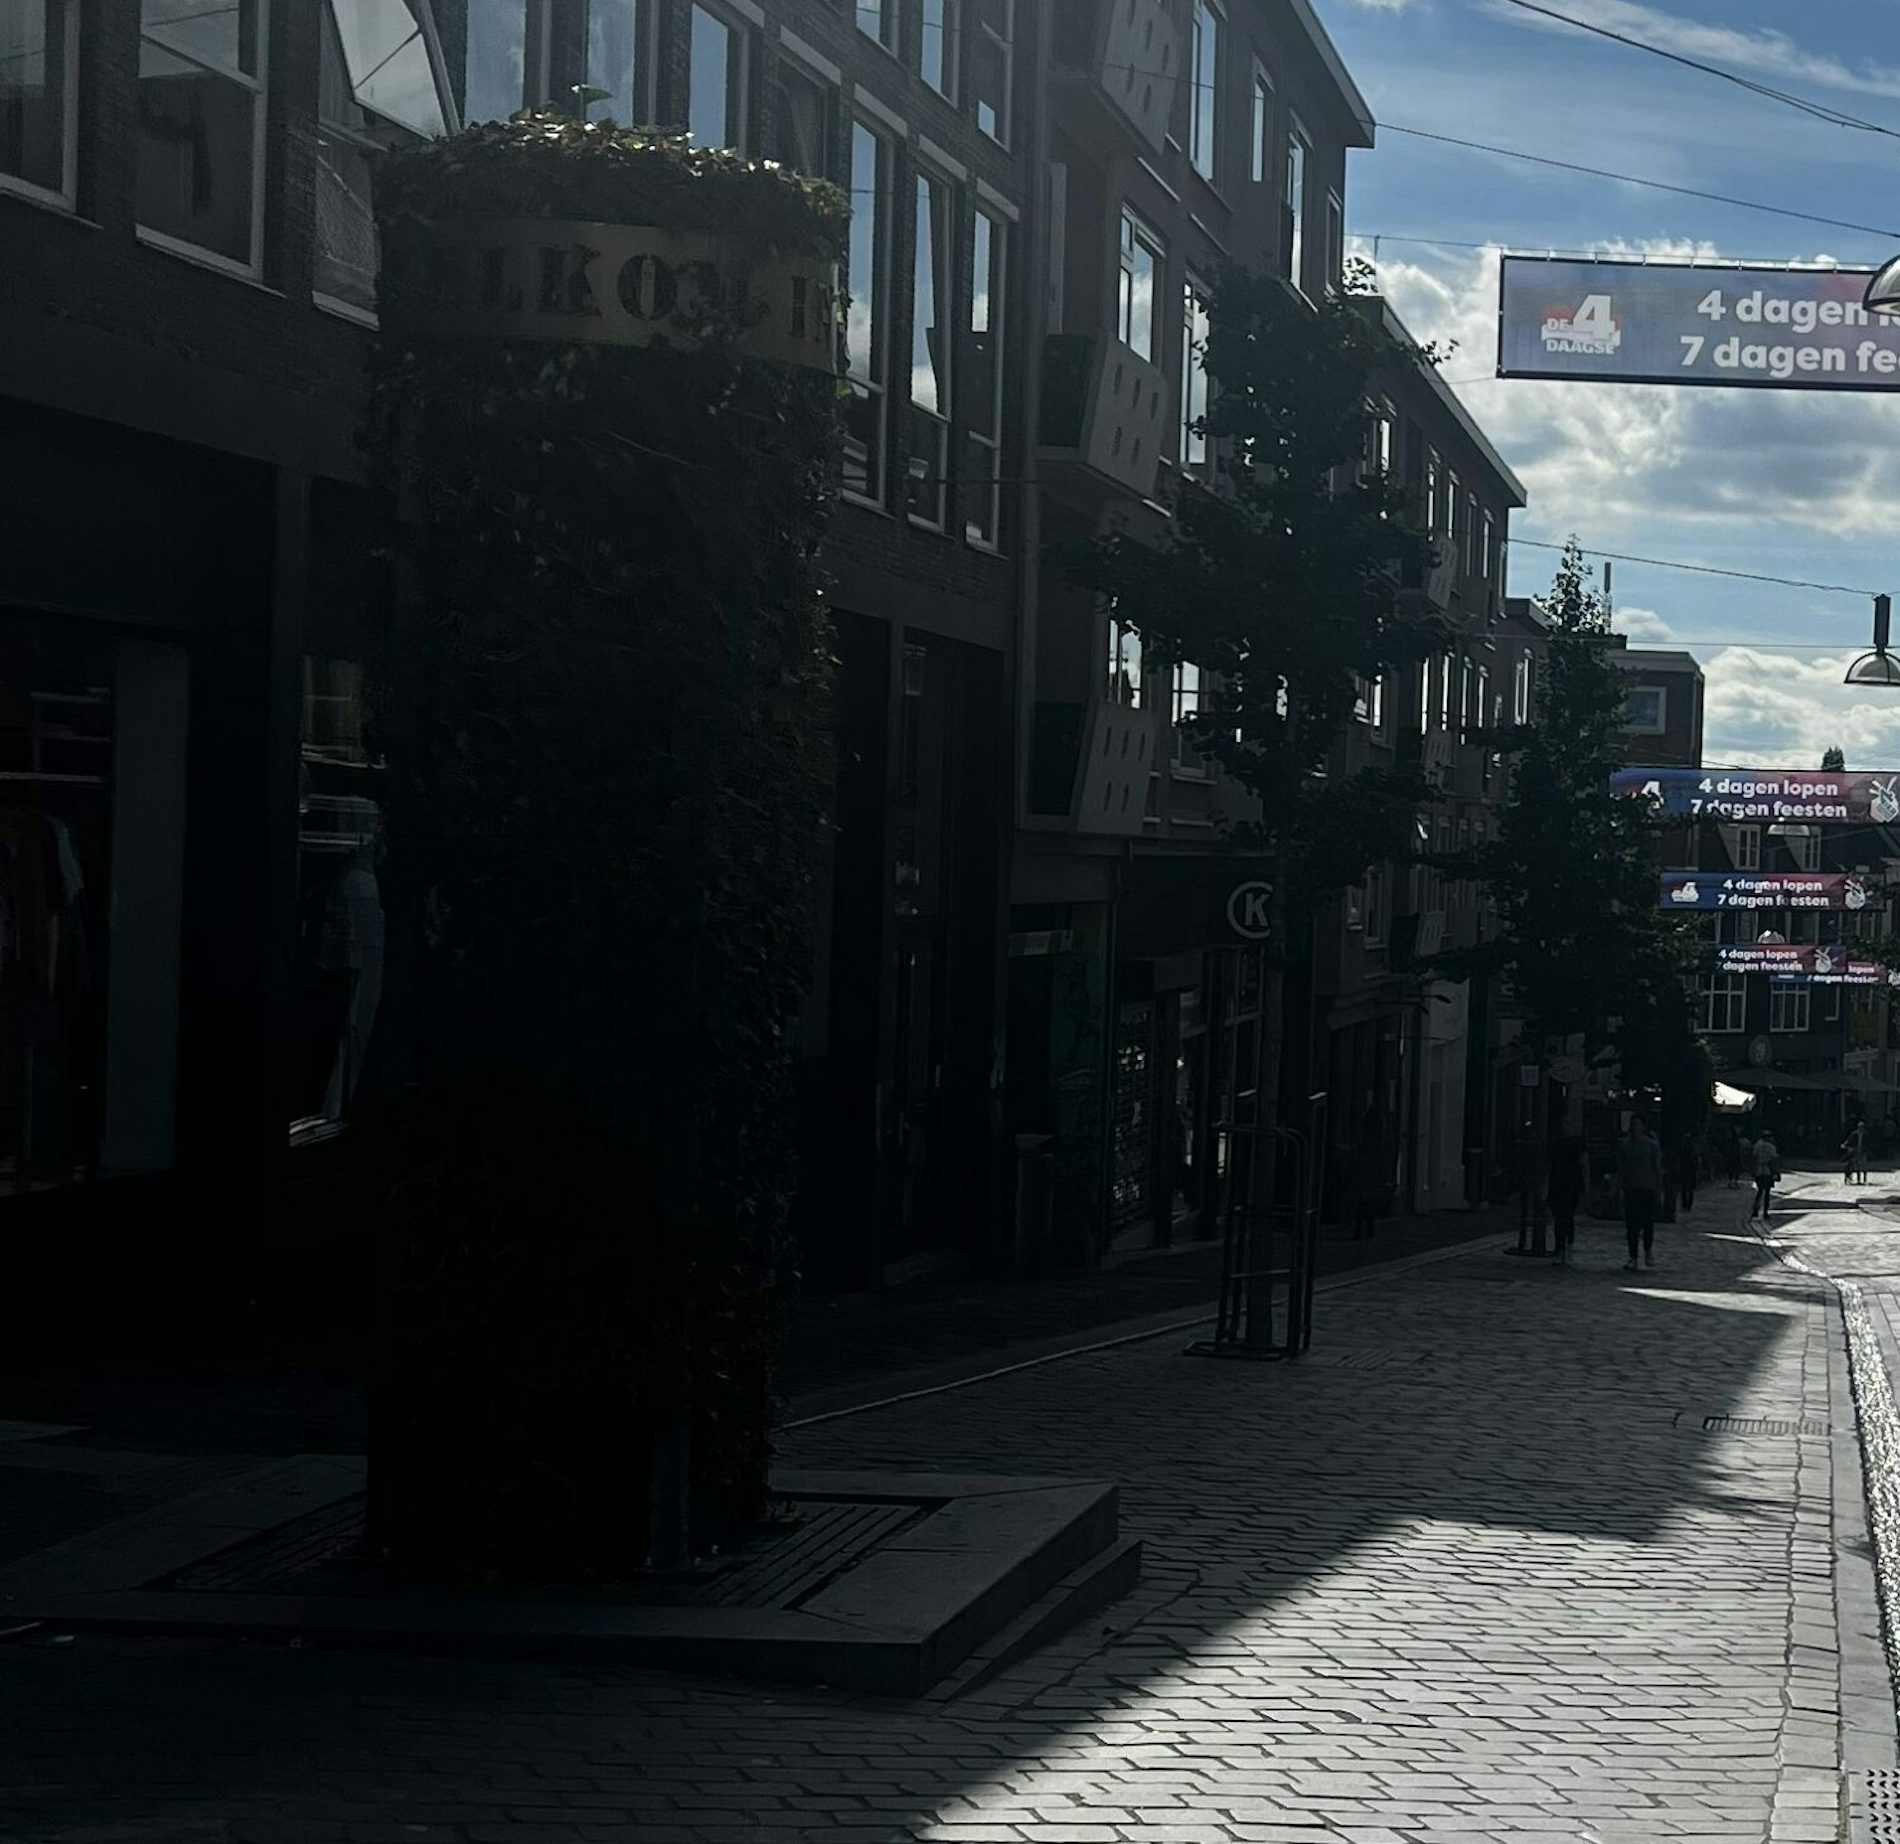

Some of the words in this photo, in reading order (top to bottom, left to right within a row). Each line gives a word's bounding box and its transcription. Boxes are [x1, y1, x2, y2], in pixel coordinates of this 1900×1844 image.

[1546, 318, 1570, 331] DE
[1573, 294, 1615, 339] 4
[1697, 290, 1726, 320] 4
[1736, 291, 1868, 333] dagen
[1546, 339, 1615, 354] DAAGSE
[1680, 336, 1704, 366] 7
[1713, 337, 1845, 378] dagen
[1699, 778, 1713, 793] 4
[1716, 778, 1779, 798] dagen
[1783, 780, 1838, 799] lopen
[1691, 799, 1702, 814] 7
[1773, 801, 1847, 818] feesten
[1723, 879, 1733, 890] 4
[1735, 879, 1780, 893] dagen
[1783, 879, 1823, 893] lopen
[1717, 894, 1727, 905] 7
[1728, 894, 1773, 908] dagen
[1728, 949, 1765, 961] dagen
[1766, 950, 1797, 961] lopen
[1722, 961, 1759, 973] dagen
